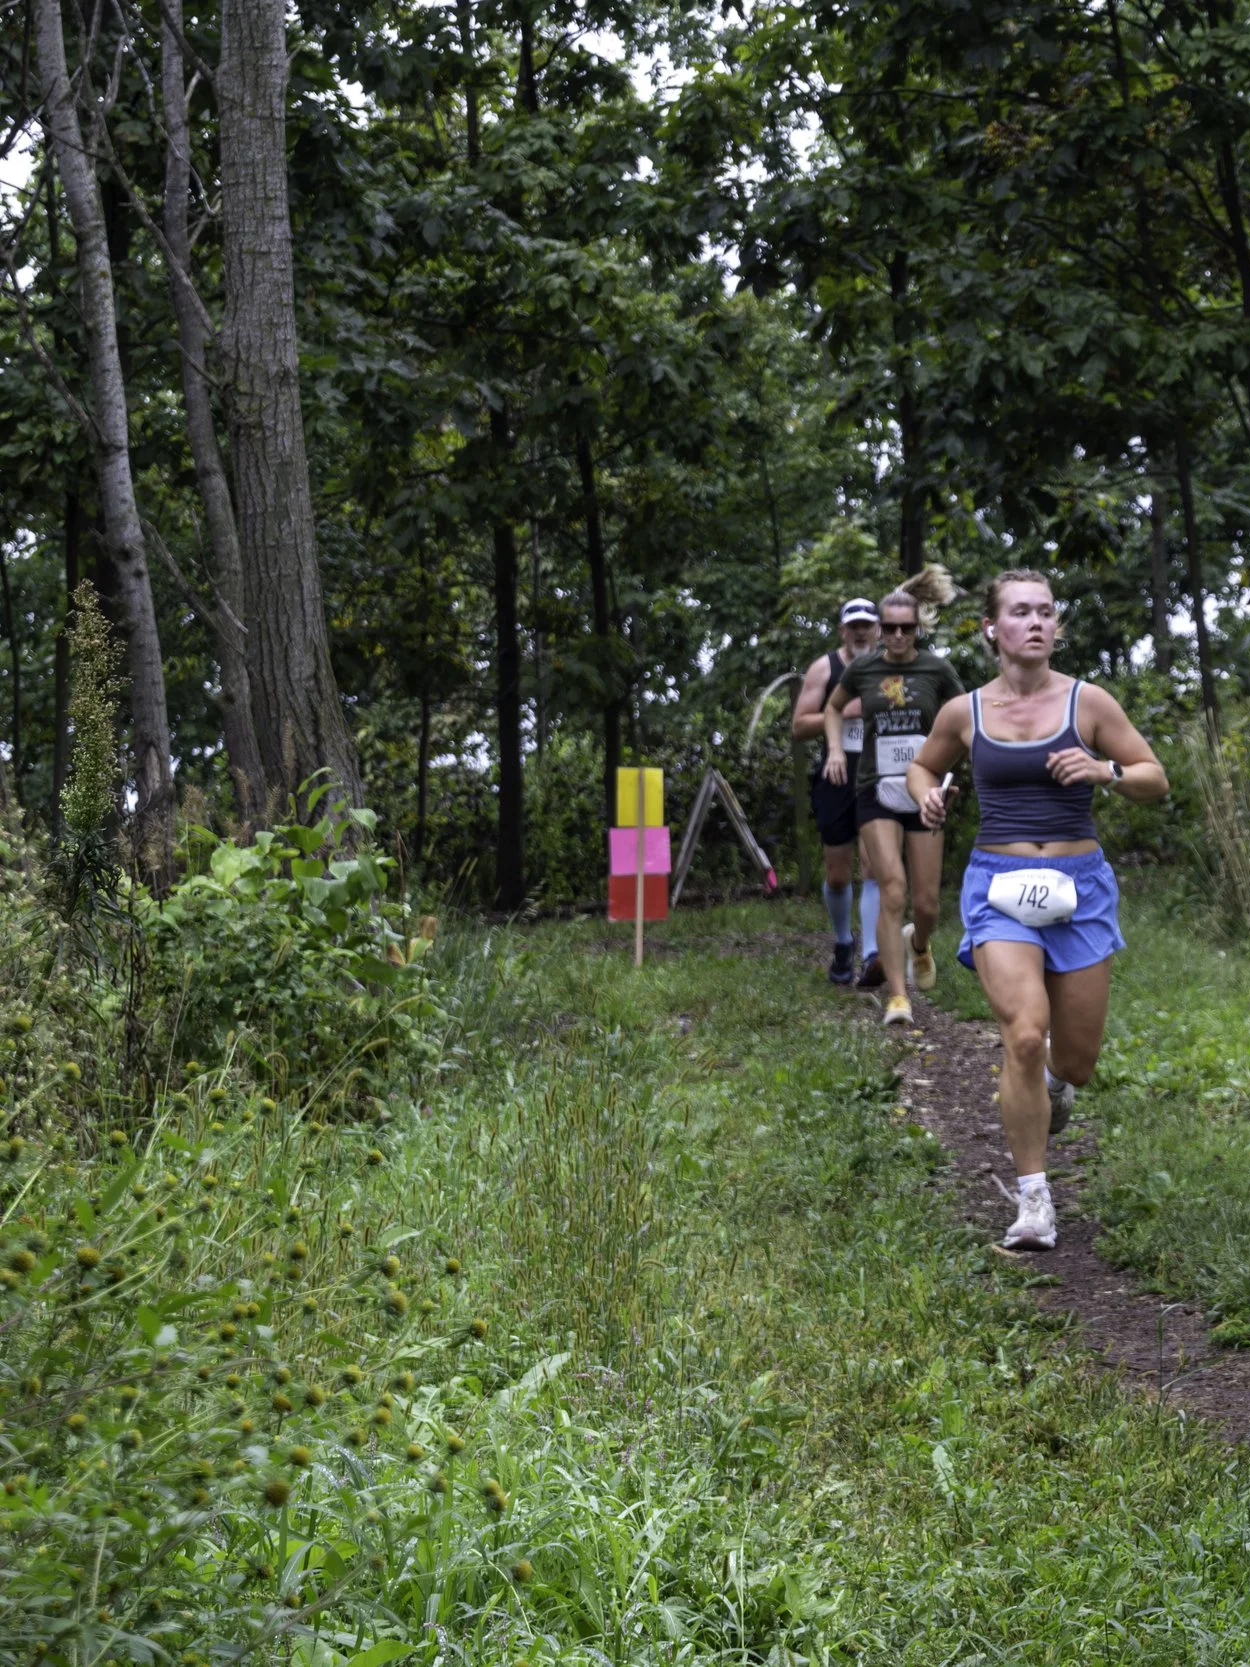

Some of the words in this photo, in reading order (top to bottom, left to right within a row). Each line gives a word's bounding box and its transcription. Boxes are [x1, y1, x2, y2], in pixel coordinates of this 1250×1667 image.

[876, 716, 921, 734] PIZZA
[894, 746, 914, 762] 350
[1018, 883, 1049, 909] 742
